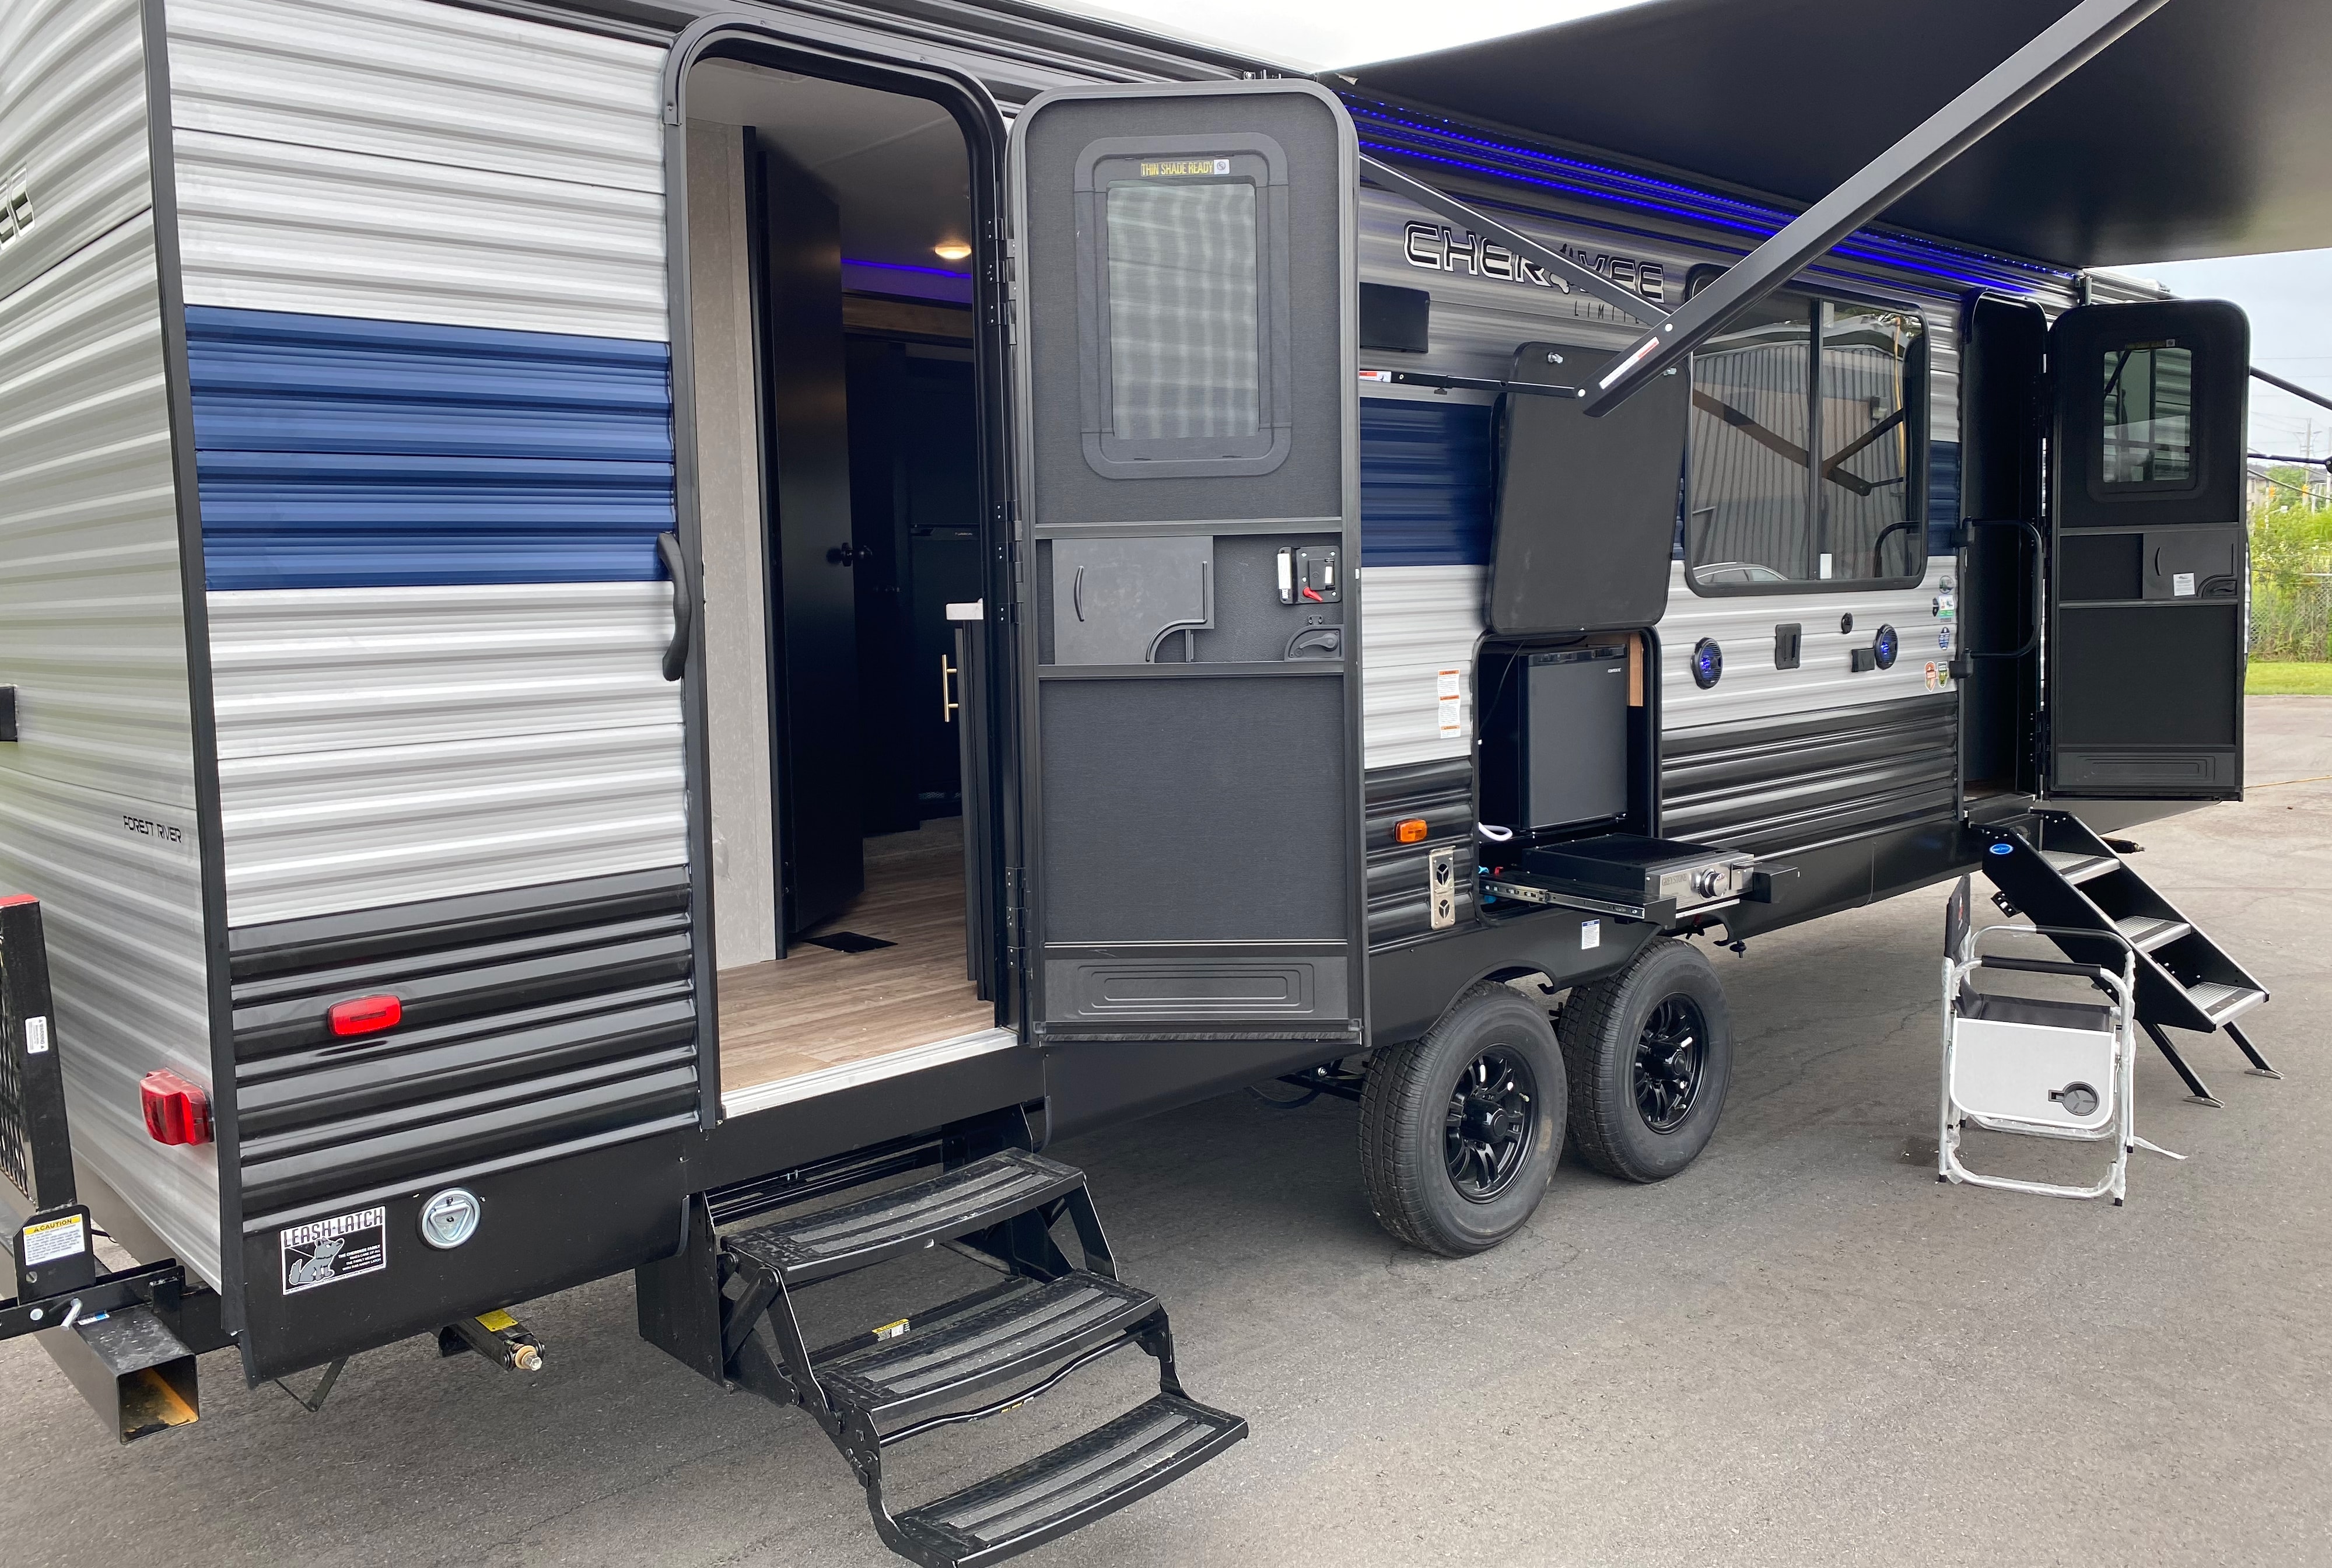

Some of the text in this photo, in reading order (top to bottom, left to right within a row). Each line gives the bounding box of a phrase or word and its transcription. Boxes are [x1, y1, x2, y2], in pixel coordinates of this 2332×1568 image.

[1141, 163, 1159, 176] THIN
[1161, 162, 1187, 175] SHADE
[1188, 161, 1213, 174] READY
[122, 815, 181, 844] FOREST RIVER
[1662, 873, 1687, 887] GREYSTONE
[40, 1219, 72, 1231] CAUTION
